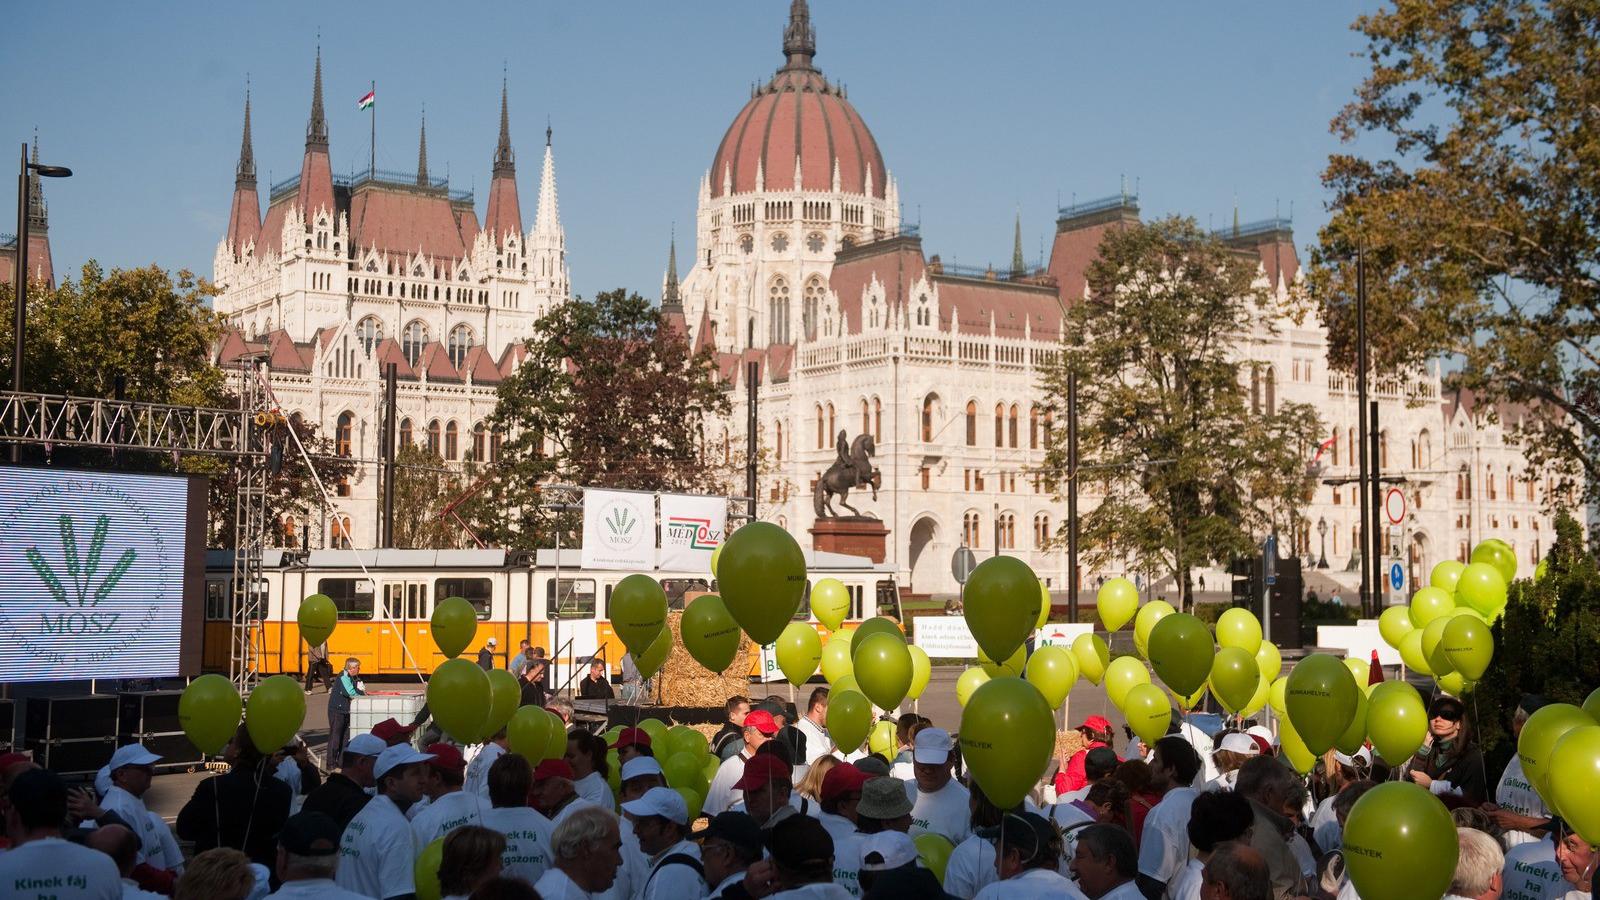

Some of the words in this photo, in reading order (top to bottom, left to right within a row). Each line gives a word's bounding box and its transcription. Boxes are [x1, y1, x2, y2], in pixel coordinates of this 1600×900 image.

[609, 536, 633, 545] MOSZ
[39, 612, 122, 637] MOSZ
[441, 815, 469, 832] Kinek
[523, 829, 537, 842] fáj
[1514, 861, 1550, 880] Kinek
[15, 876, 63, 890] Kinek
[66, 874, 88, 890] fáj
[1524, 879, 1542, 893] ha
